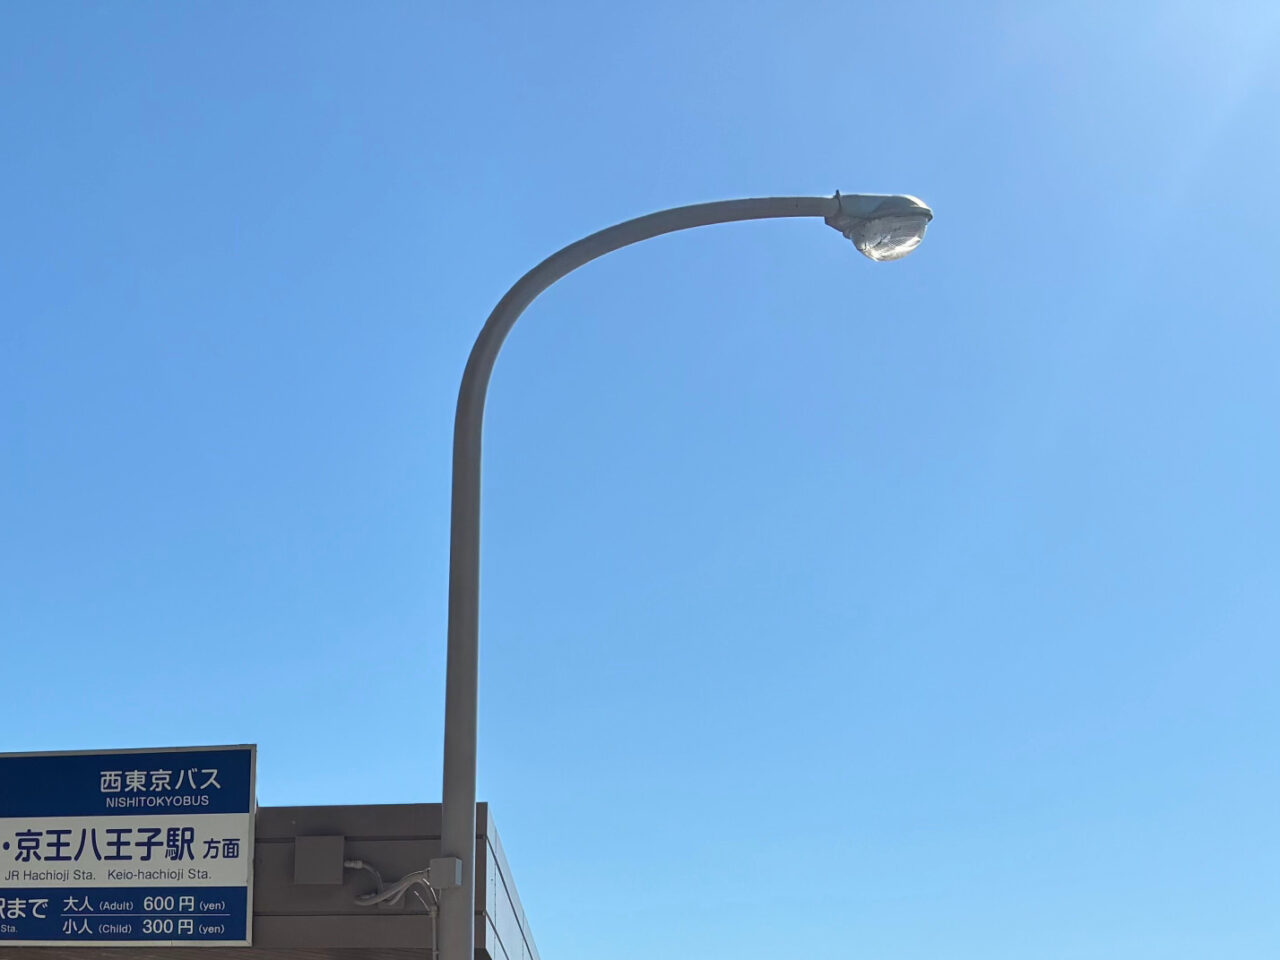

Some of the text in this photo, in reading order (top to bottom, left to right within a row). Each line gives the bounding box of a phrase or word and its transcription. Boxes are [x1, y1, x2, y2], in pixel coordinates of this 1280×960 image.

[101, 768, 220, 792] 西東京バス
[107, 795, 208, 807] NISHITOKYOBUS
[203, 838, 240, 859] 方面
[5, 870, 19, 880] JR
[24, 870, 69, 881] Hachioji
[73, 869, 95, 880] Sta.
[108, 869, 183, 880] Keio-hachioji
[188, 868, 211, 879] Sta.
[64, 896, 93, 911] 大人
[100, 902, 133, 910] (Adult)
[200, 901, 225, 911] (yen)
[63, 919, 92, 934] 小人
[99, 924, 131, 933] (Child)
[199, 925, 224, 934] (yen)
